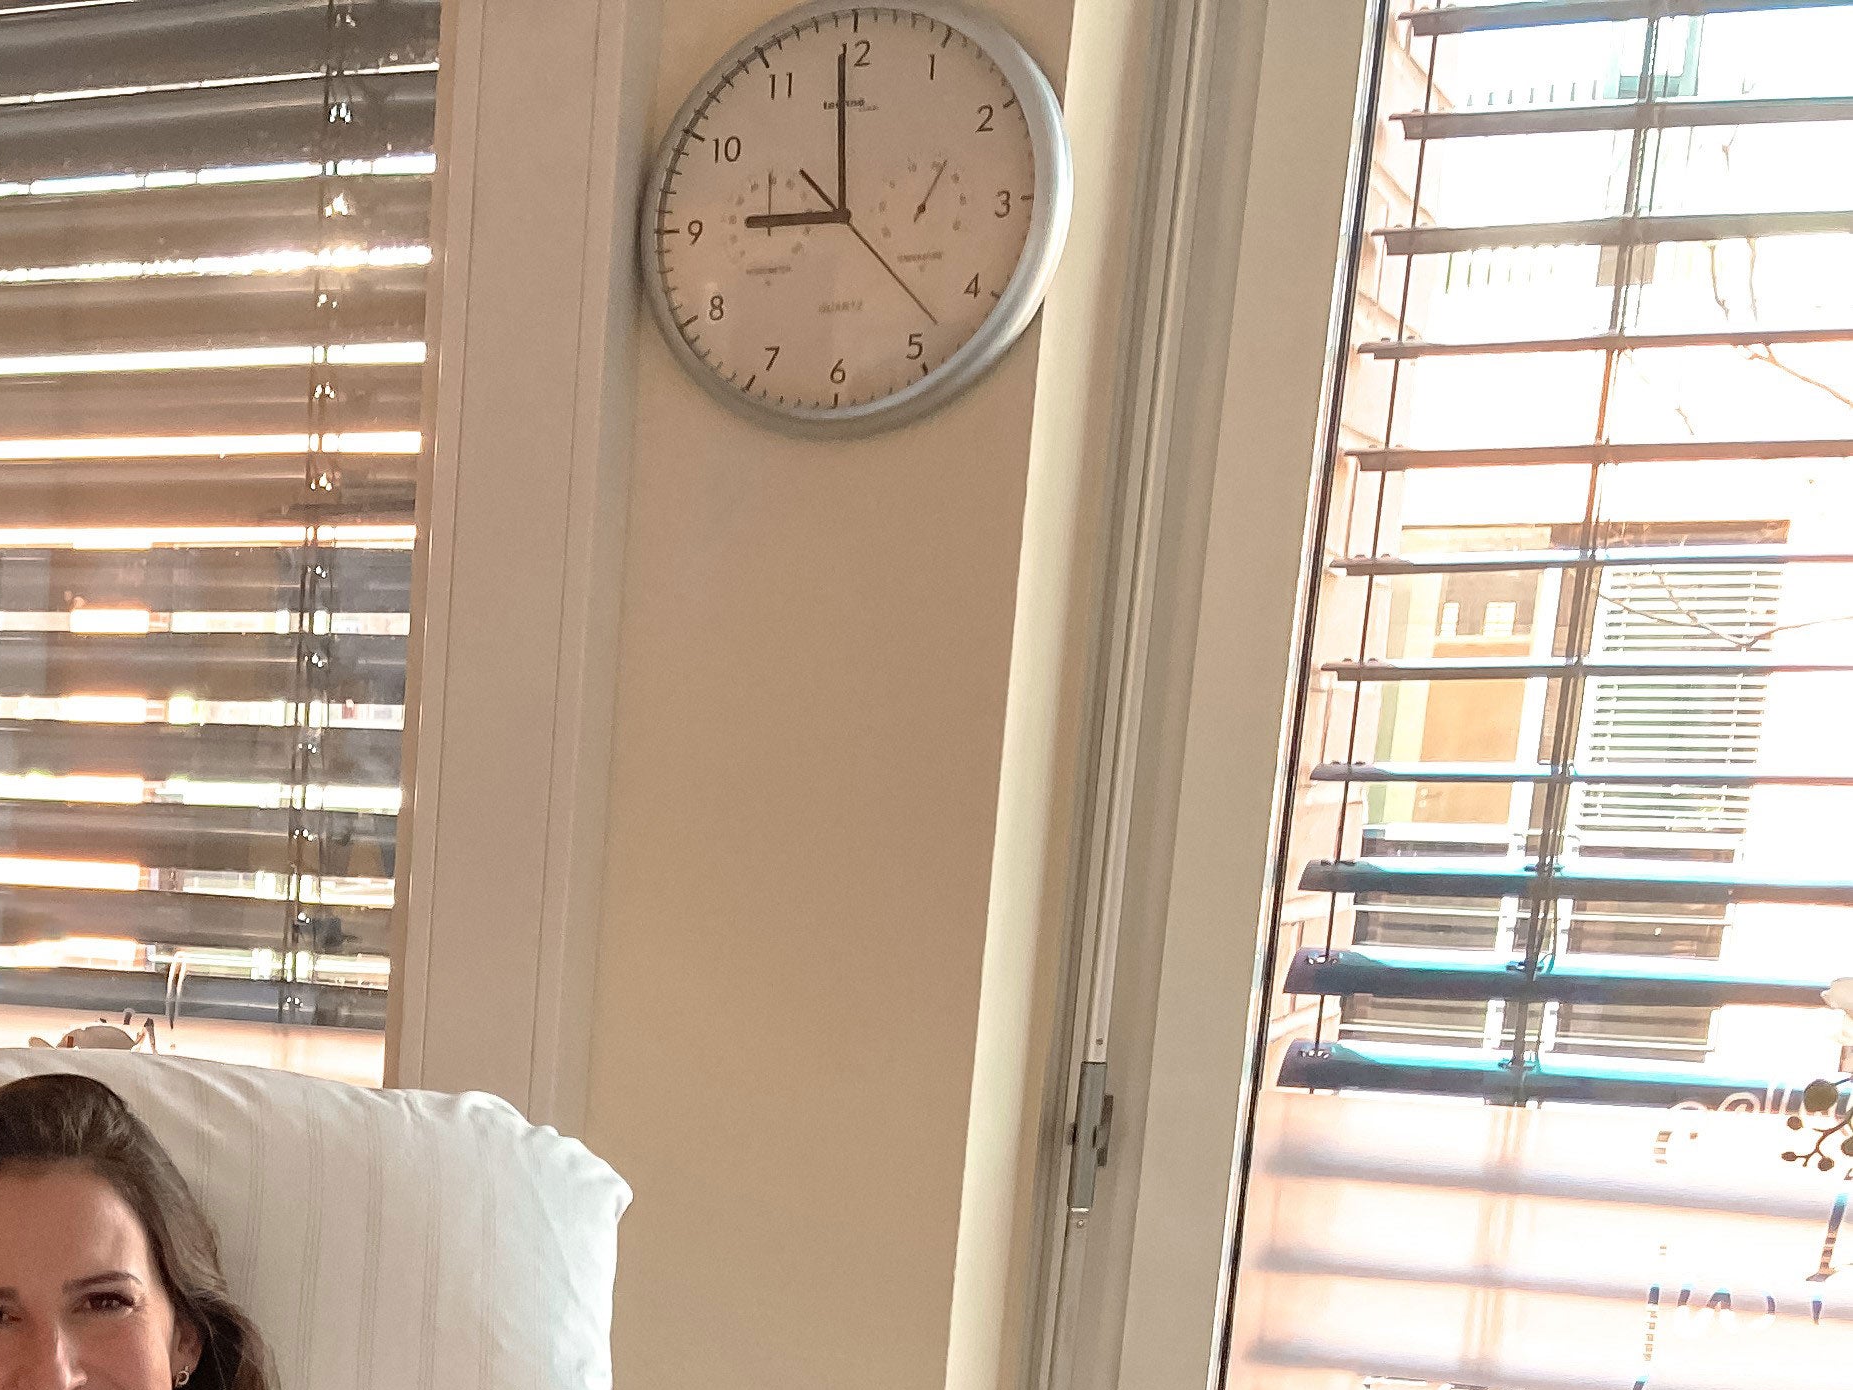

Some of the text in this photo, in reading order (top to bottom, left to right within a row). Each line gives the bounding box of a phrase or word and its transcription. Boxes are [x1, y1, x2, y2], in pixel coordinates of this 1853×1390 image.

[927, 53, 937, 81] 1
[768, 71, 794, 98] 11
[975, 105, 995, 133] 2
[712, 136, 742, 164] 10
[994, 190, 1012, 218] 3
[687, 219, 704, 247] 9
[963, 273, 981, 299] 4
[708, 295, 725, 322] 8
[764, 345, 781, 372] 7
[906, 333, 924, 361] 5
[829, 358, 846, 385] 6
